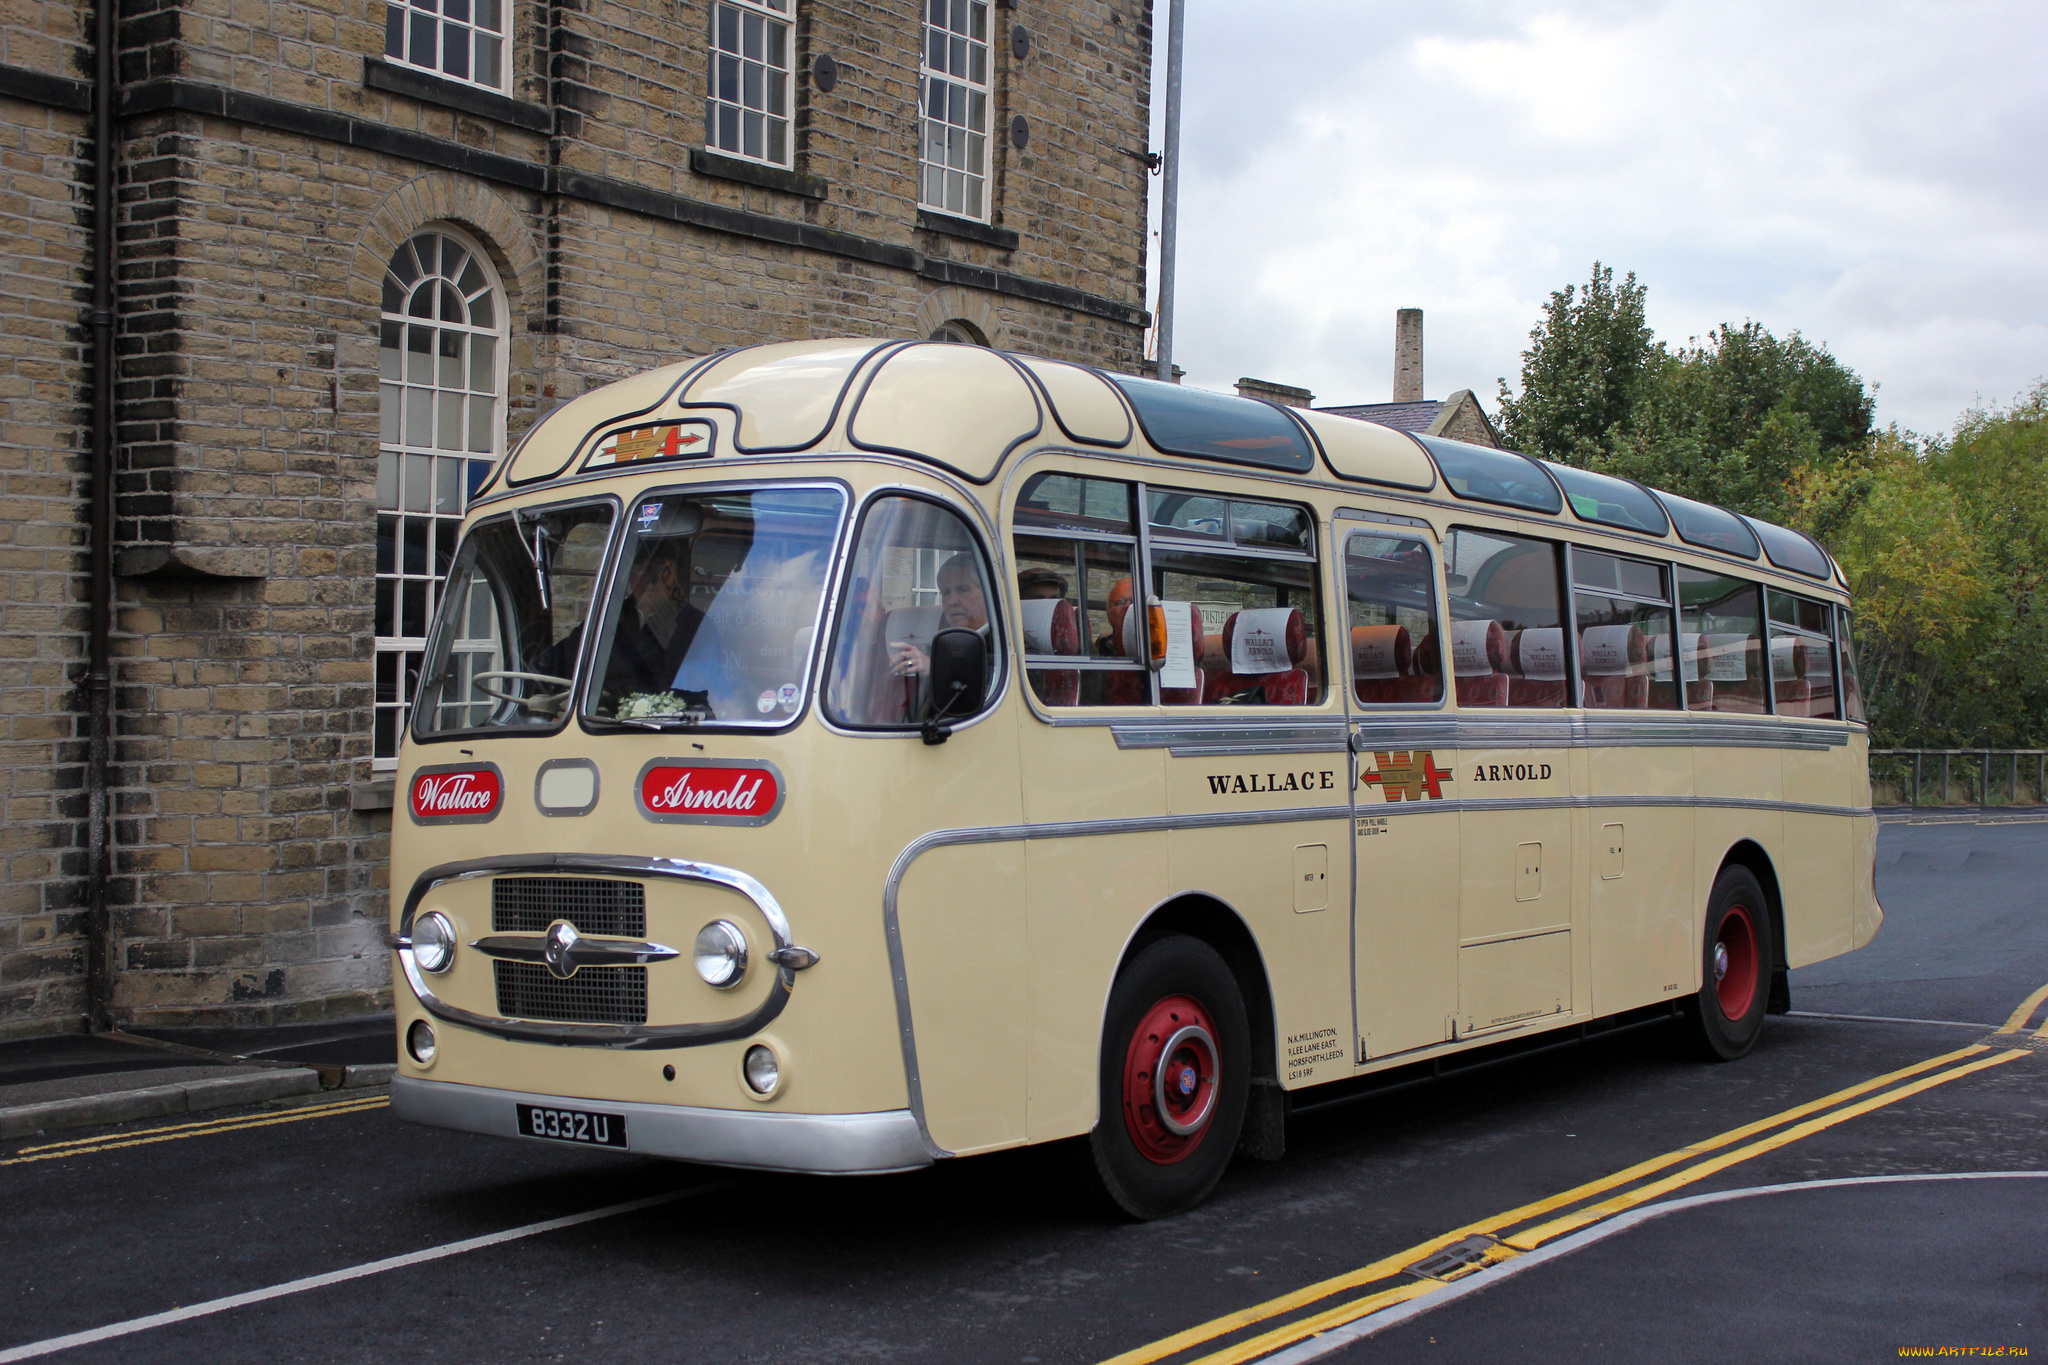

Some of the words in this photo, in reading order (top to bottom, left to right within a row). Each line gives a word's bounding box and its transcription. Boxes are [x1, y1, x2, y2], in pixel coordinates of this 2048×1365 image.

[1244, 638, 1275, 647] WALLACE
[1248, 647, 1274, 656] ARNOLD
[1454, 648, 1477, 656] ALLACE
[1530, 654, 1557, 662] WALLACE
[1474, 764, 1552, 783] ARNOLD
[1207, 770, 1335, 795] WALLACE
[418, 774, 491, 811] Wallace
[652, 773, 764, 811] Arnold
[1304, 1042, 1320, 1053] LANE
[1289, 1070, 1302, 1080] LS18
[531, 1108, 590, 1141] 8332
